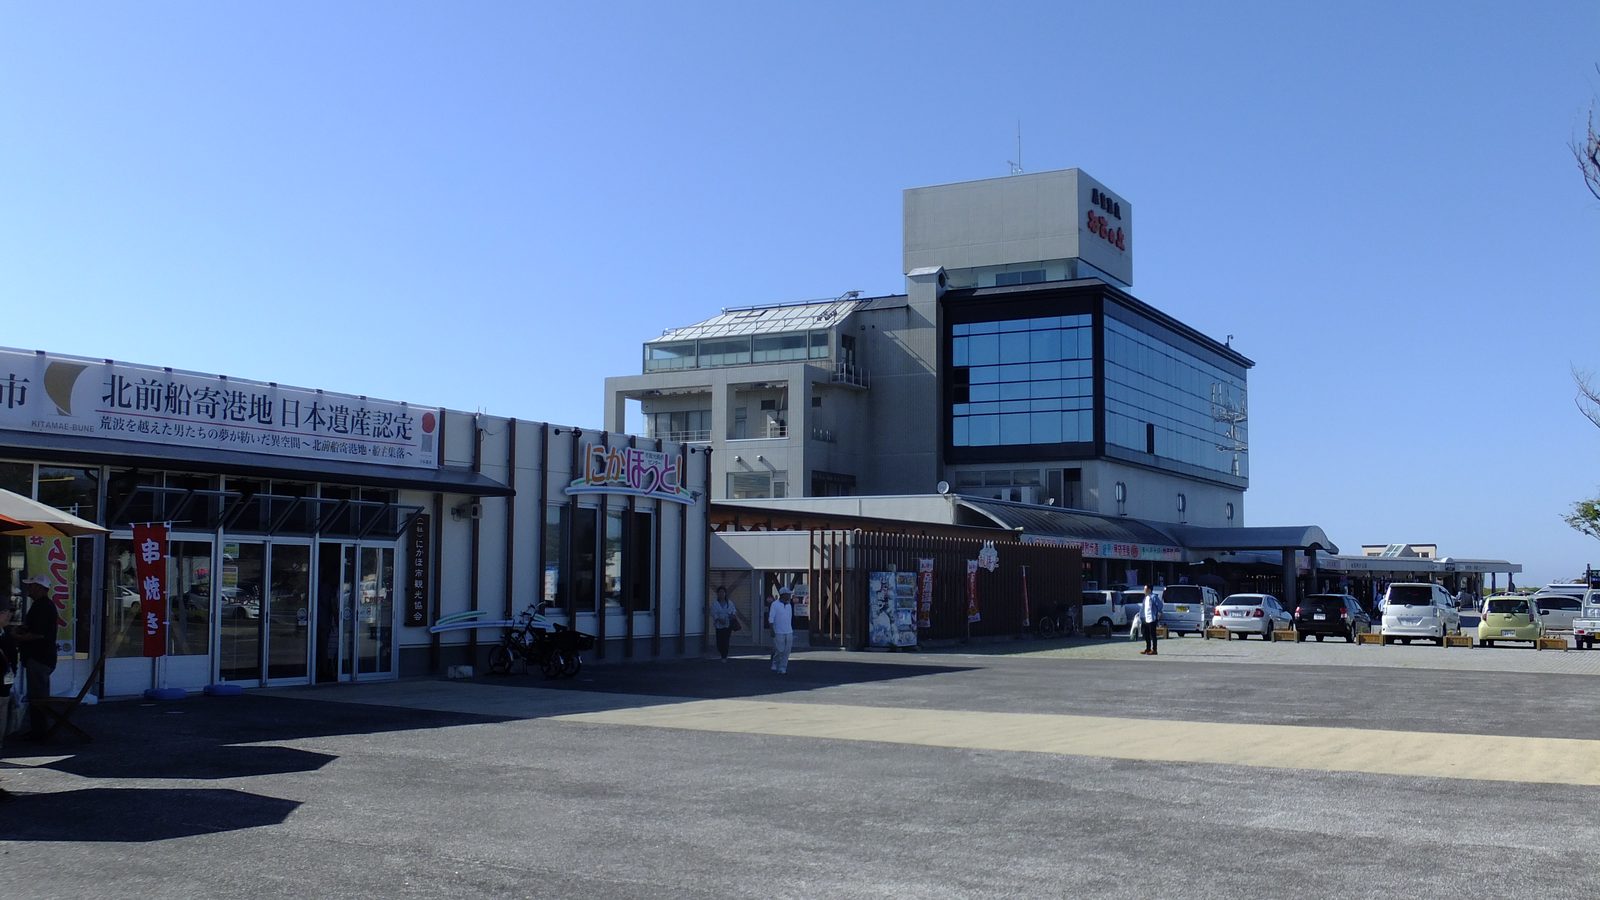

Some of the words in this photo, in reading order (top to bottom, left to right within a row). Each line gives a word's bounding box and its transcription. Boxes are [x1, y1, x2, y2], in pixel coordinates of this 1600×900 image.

[0, 373, 30, 409] 市
[32, 420, 94, 433] KITAMAE-BUNE
[141, 538, 161, 636] 串焼き
